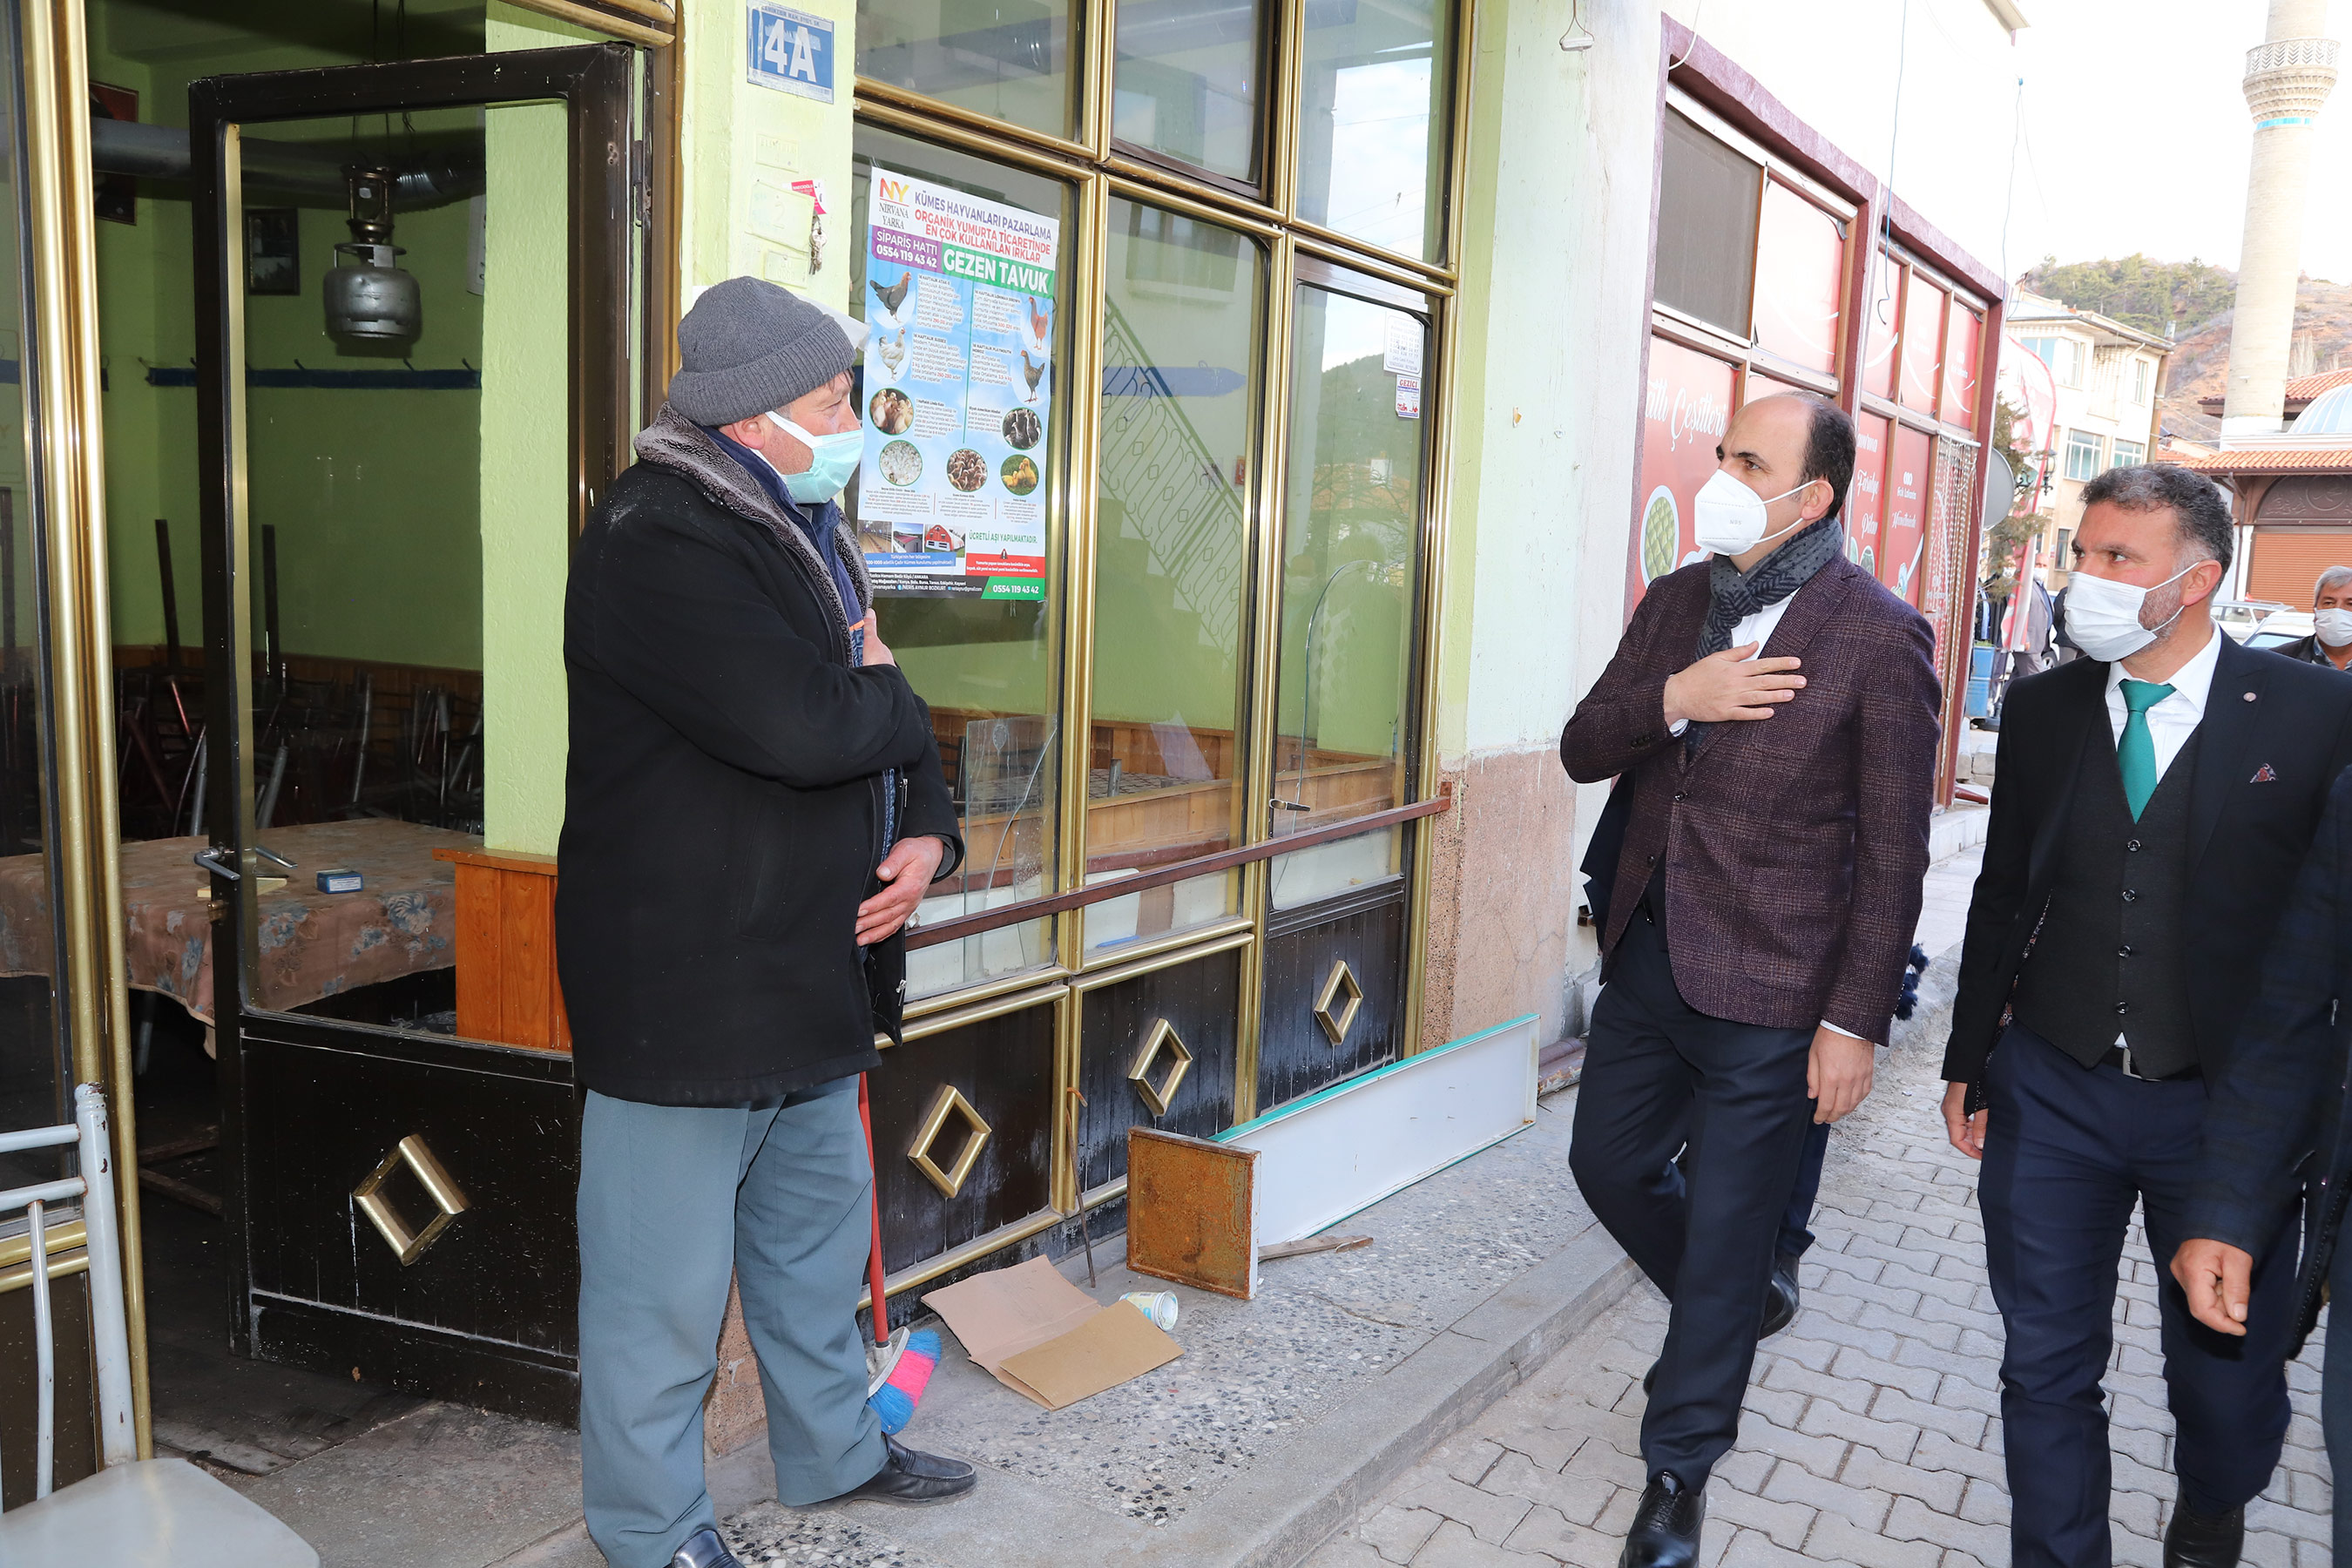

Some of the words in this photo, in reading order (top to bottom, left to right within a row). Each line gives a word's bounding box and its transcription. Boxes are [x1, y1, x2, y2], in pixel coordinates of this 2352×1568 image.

[765, 18, 816, 83] 4A
[880, 178, 909, 202] NY
[882, 215, 904, 229] YARKA
[915, 191, 945, 212] KÜMES
[947, 201, 1001, 227] HAYVANLARI
[1003, 217, 1051, 240] PAZARLAMA
[915, 209, 955, 230] ORGANİK
[956, 220, 997, 240] YUMURTA
[999, 230, 1051, 254] TİCARETİNDE
[926, 224, 937, 237] EN
[939, 228, 957, 242] ÇOK
[876, 229, 911, 251] SİPARİŞ
[913, 240, 937, 255] HATTI
[876, 244, 899, 259] 0554
[900, 249, 913, 261] 119
[914, 253, 925, 265] 43
[926, 256, 937, 268] 42
[943, 248, 997, 281] GEZEN
[999, 261, 1050, 294] TAVUK
[1671, 387, 1727, 452] Çeşitleri
